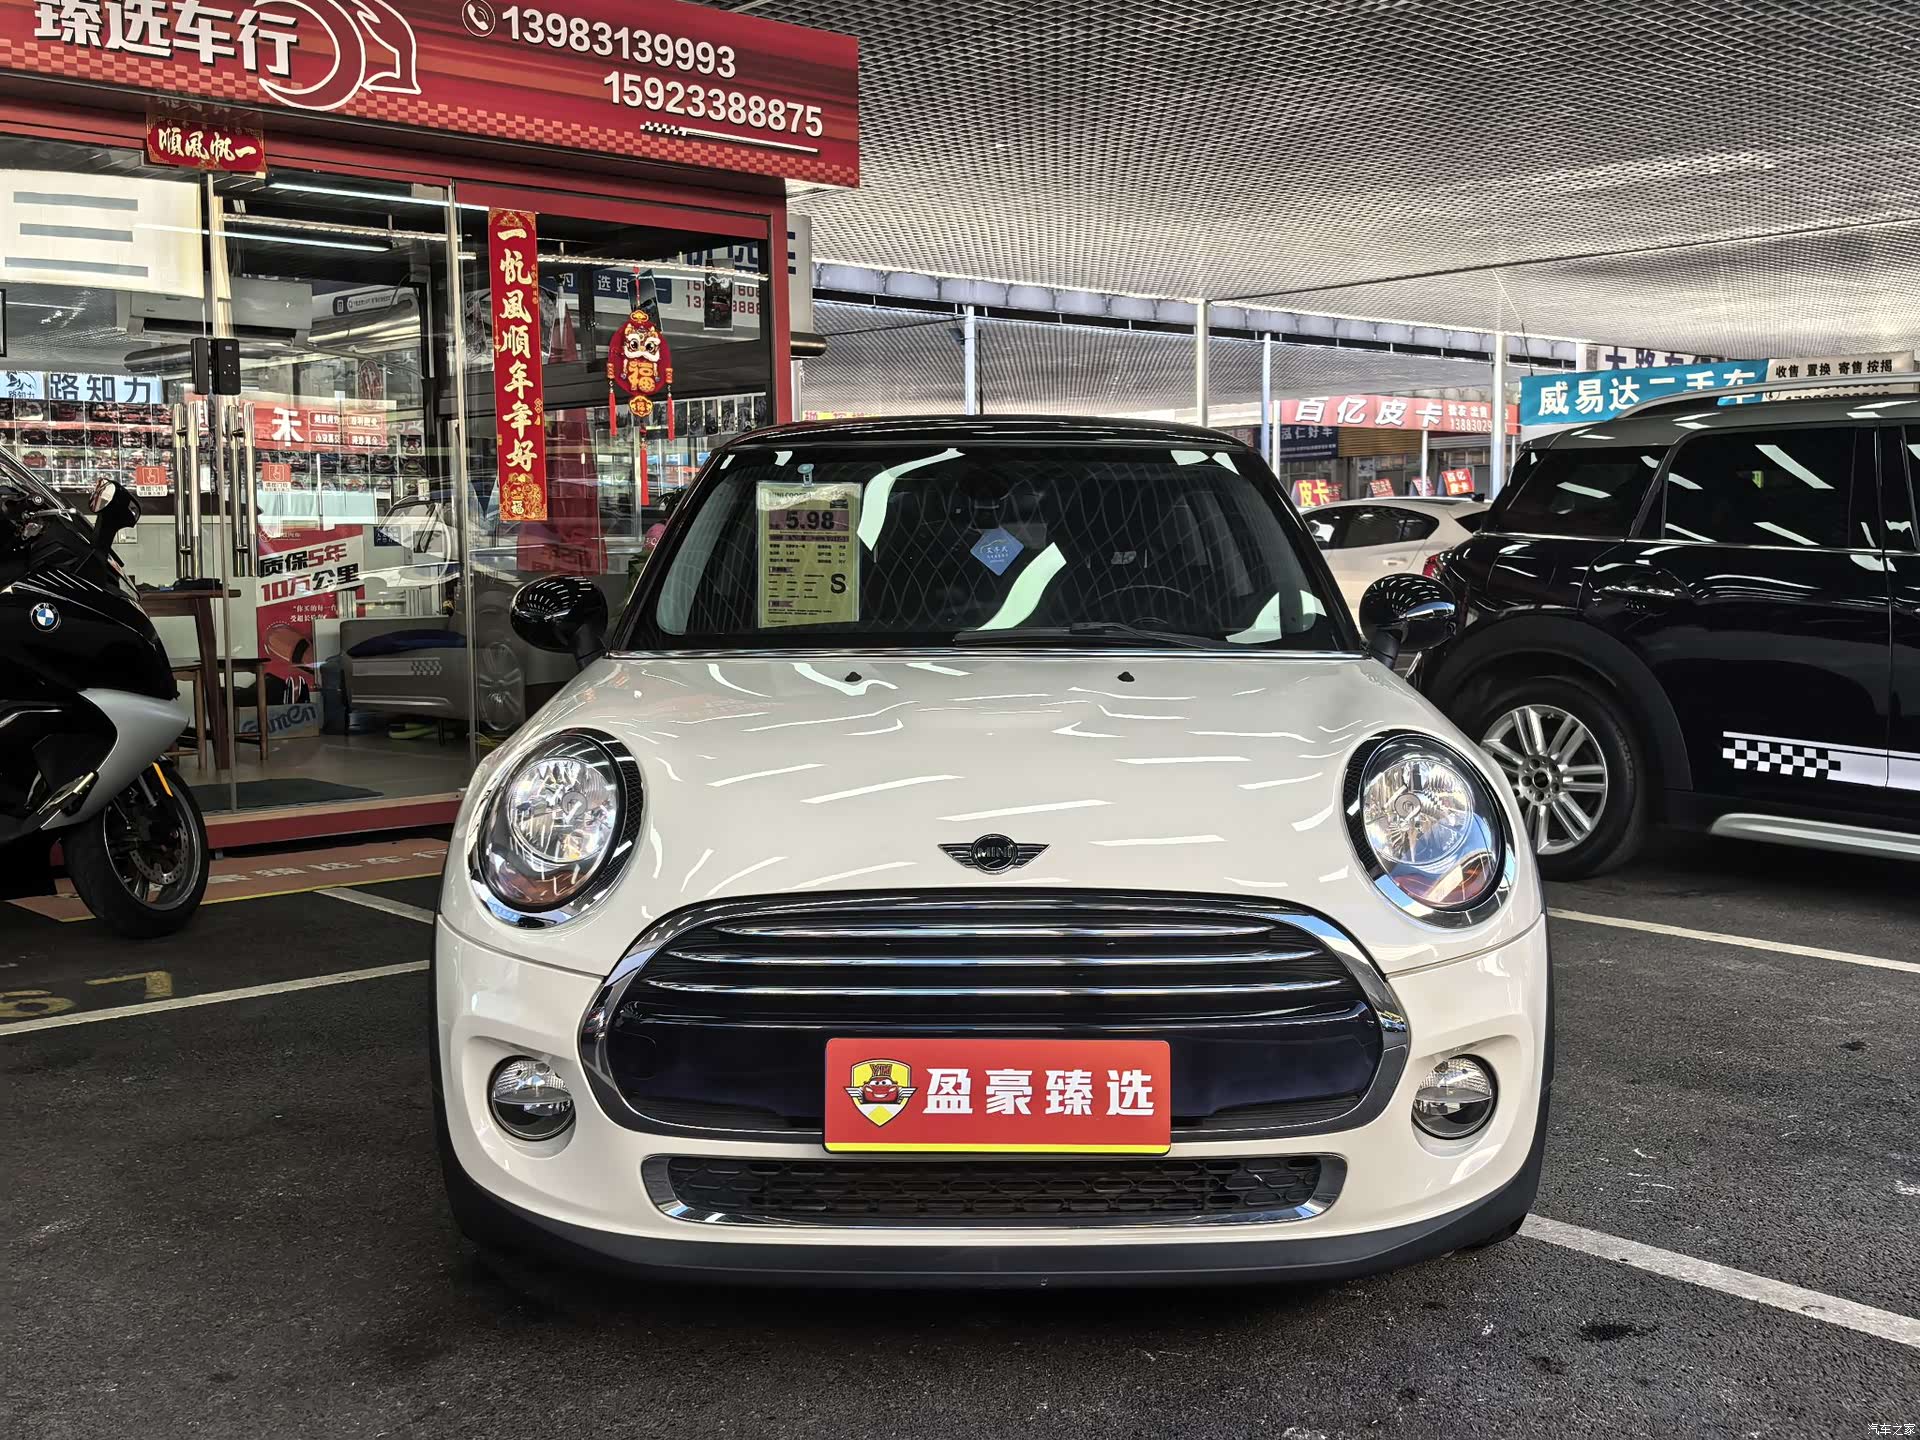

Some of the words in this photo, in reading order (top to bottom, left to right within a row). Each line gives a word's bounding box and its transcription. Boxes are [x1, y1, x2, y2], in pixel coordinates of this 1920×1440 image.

[502, 5, 736, 78] 13983139993
[604, 71, 823, 137] 15923388875
[1806, 363, 1831, 377] 置换
[1838, 361, 1862, 374] 寄售
[1867, 359, 1893, 373] 按揭
[1538, 368, 1757, 417] 威易达二手车
[1295, 397, 1443, 428] 百亿皮卡
[1449, 418, 1508, 432] 13883029
[1298, 480, 1330, 507] 皮卡
[786, 510, 835, 530] 5.98
[259, 543, 347, 578] 质保5年
[261, 563, 360, 602] 10万公里
[830, 573, 847, 594] S
[922, 1067, 1155, 1116] 盈豪臻选
